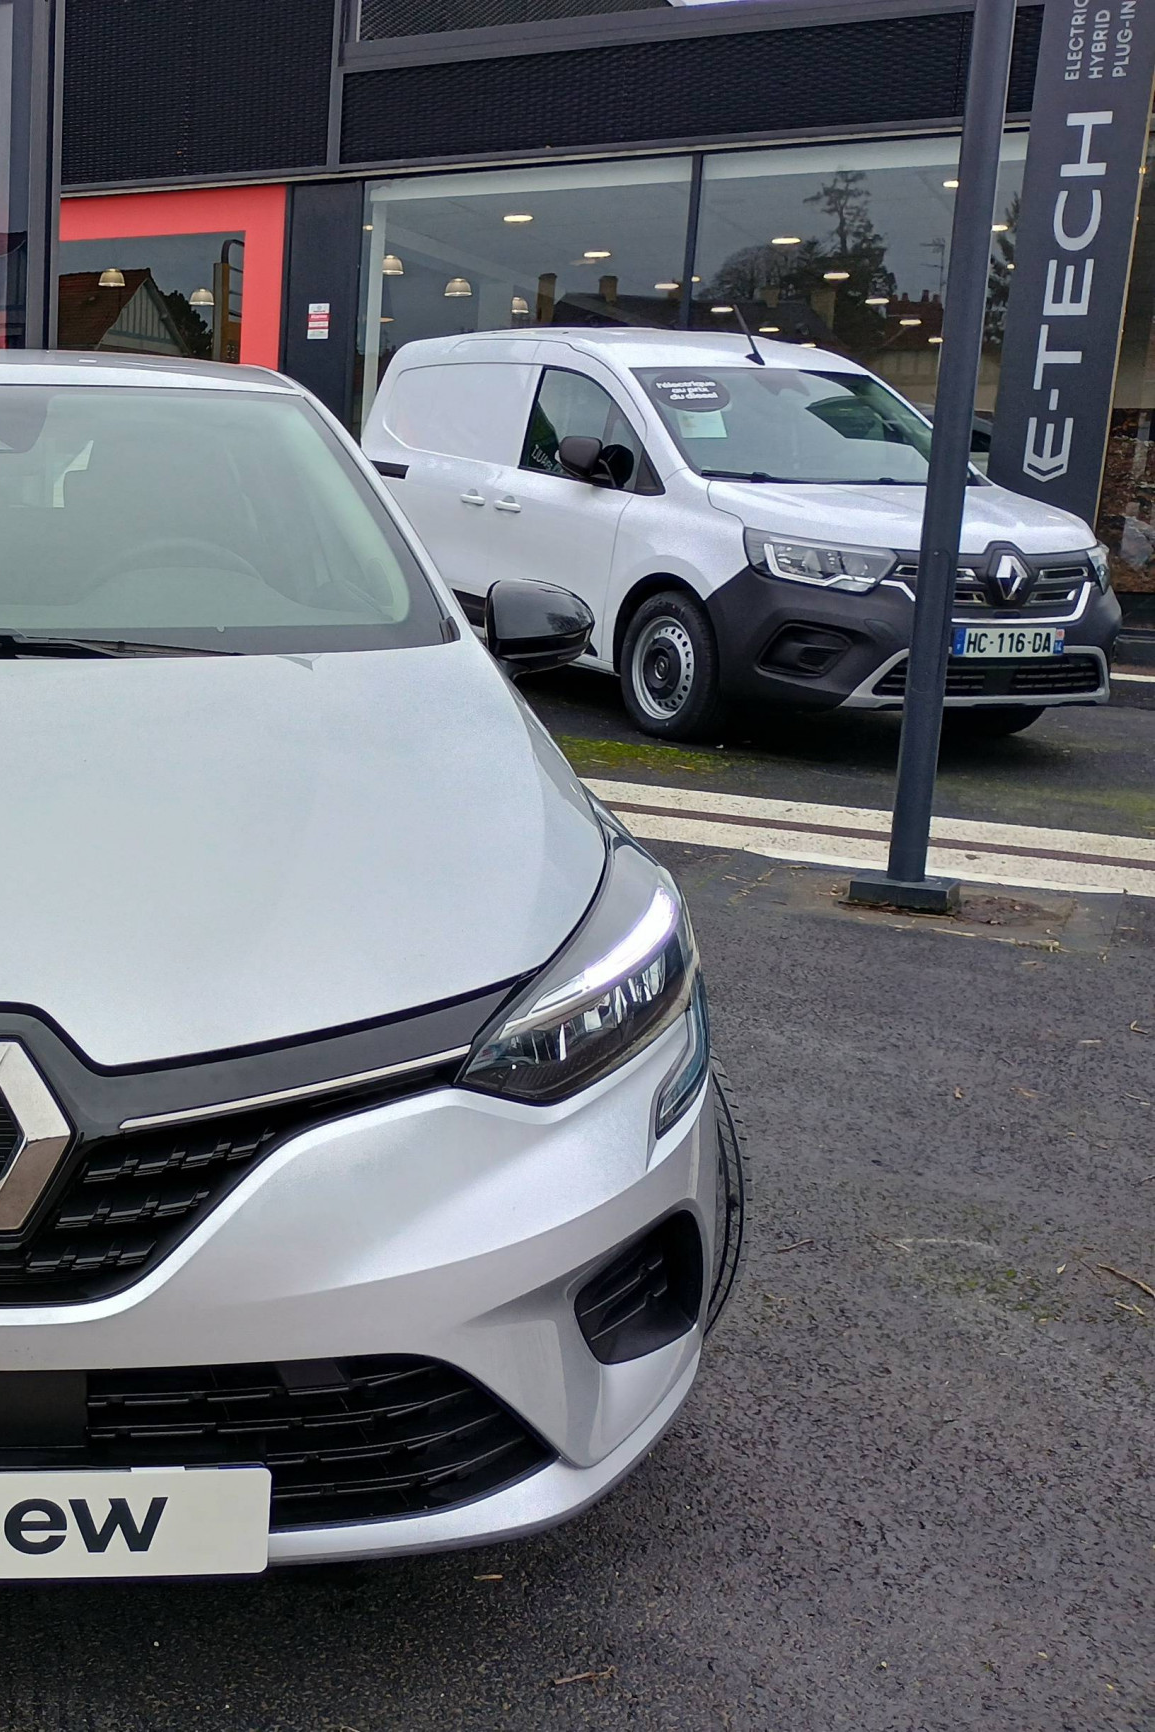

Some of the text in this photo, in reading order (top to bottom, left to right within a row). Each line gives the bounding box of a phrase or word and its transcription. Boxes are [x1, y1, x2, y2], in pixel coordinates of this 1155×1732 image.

[1088, 9, 1111, 79] HYBRID
[1112, 0, 1137, 77] PLUG-IN
[1023, 110, 1113, 482] E-TECH
[966, 632, 1051, 653] HC-116-DA
